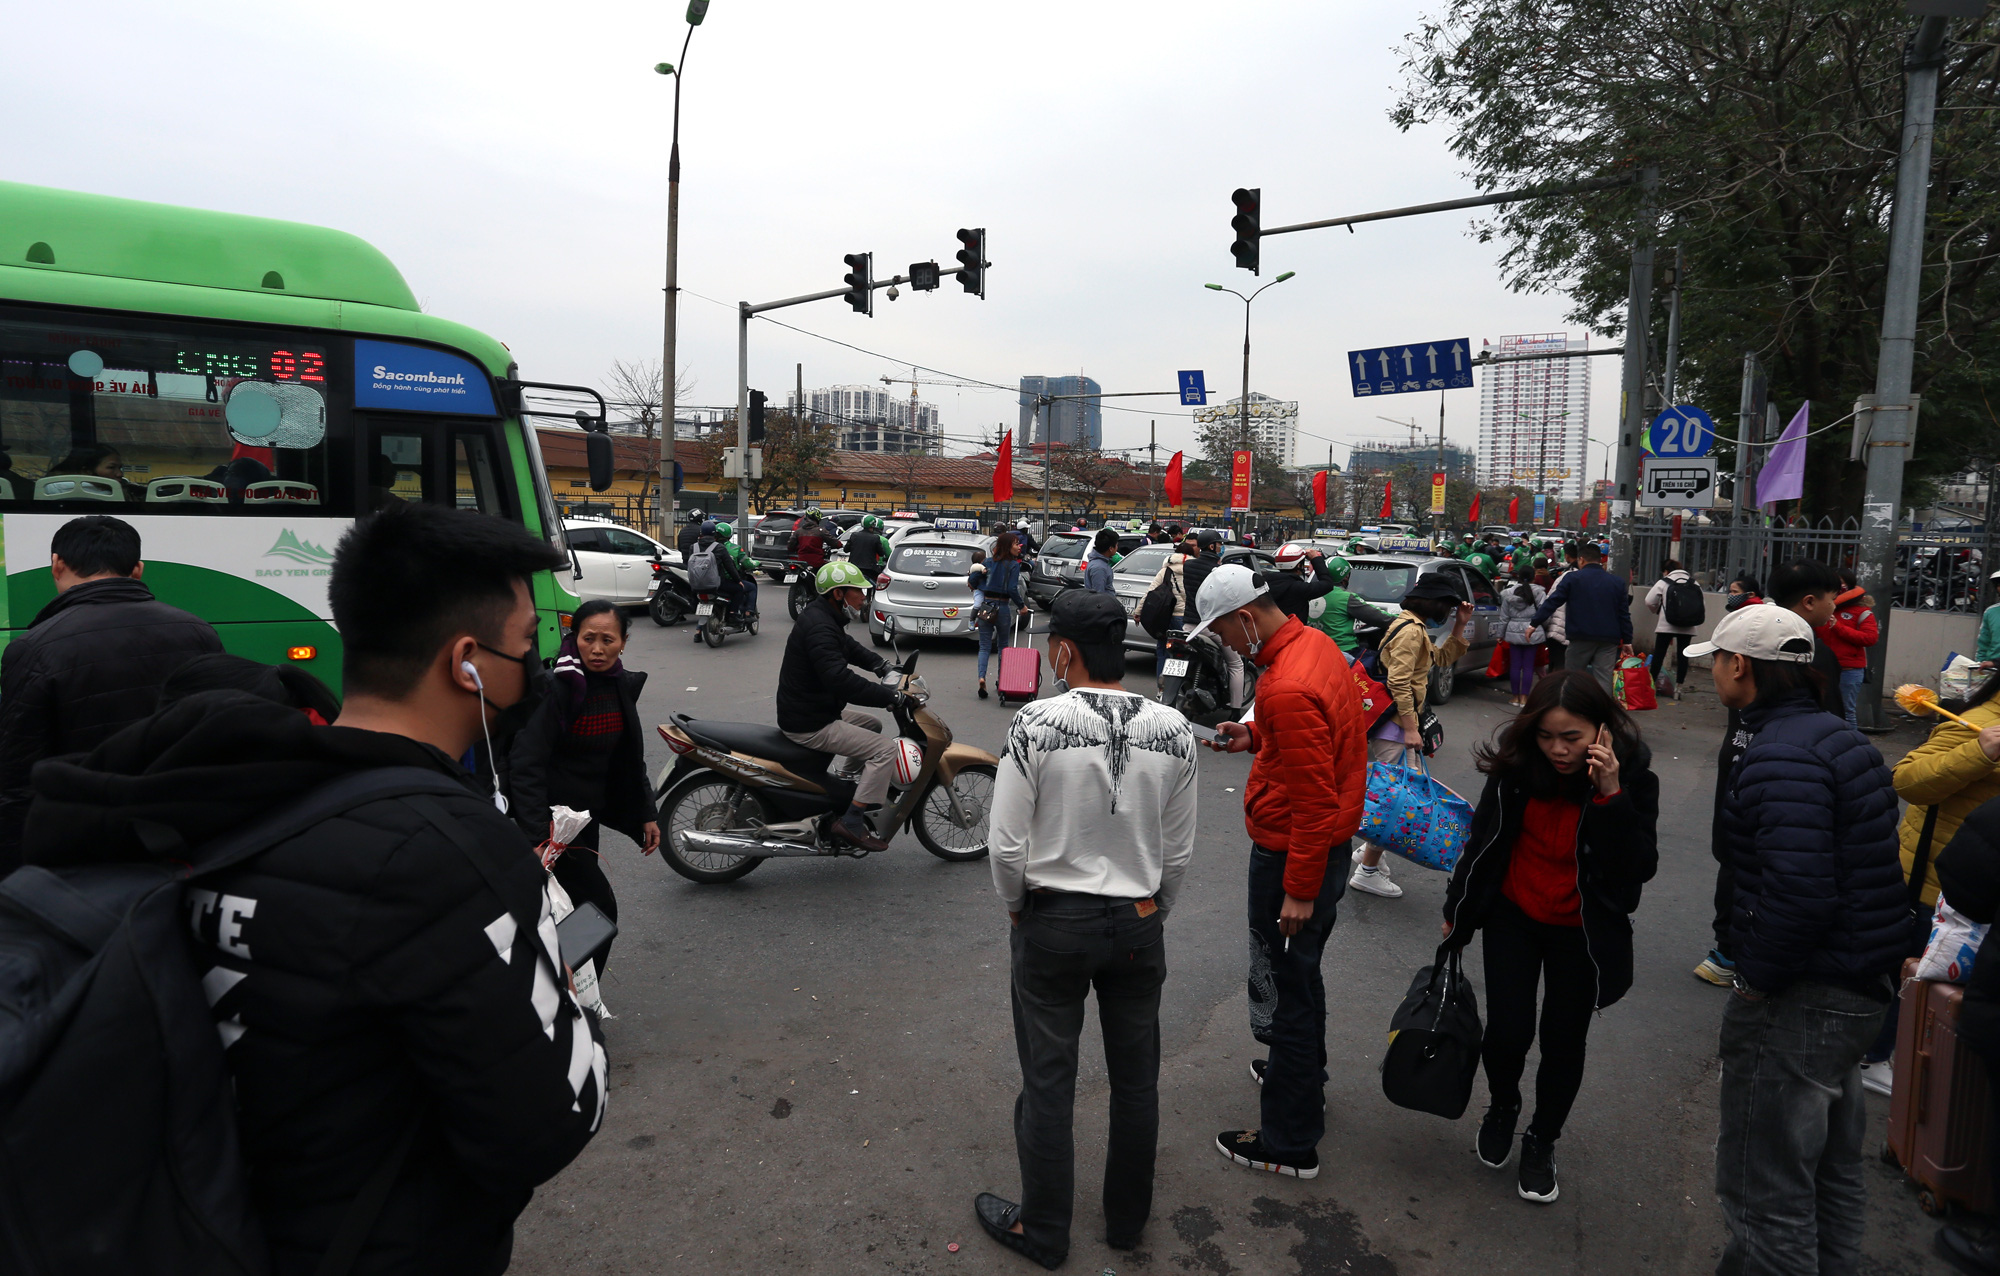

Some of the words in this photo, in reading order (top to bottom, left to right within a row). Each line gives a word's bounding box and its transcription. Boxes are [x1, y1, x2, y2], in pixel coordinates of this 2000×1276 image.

[177, 351, 257, 377] CNG
[271, 350, 325, 381] 02
[372, 365, 465, 385] Sacombank
[372, 382, 392, 391] Đồng
[413, 385, 432, 394] cùng
[1660, 417, 1702, 453] 20
[1393, 540, 1407, 548] SAO
[255, 569, 283, 577] BAO
[285, 569, 309, 577] YEN
[922, 619, 935, 627] 30A
